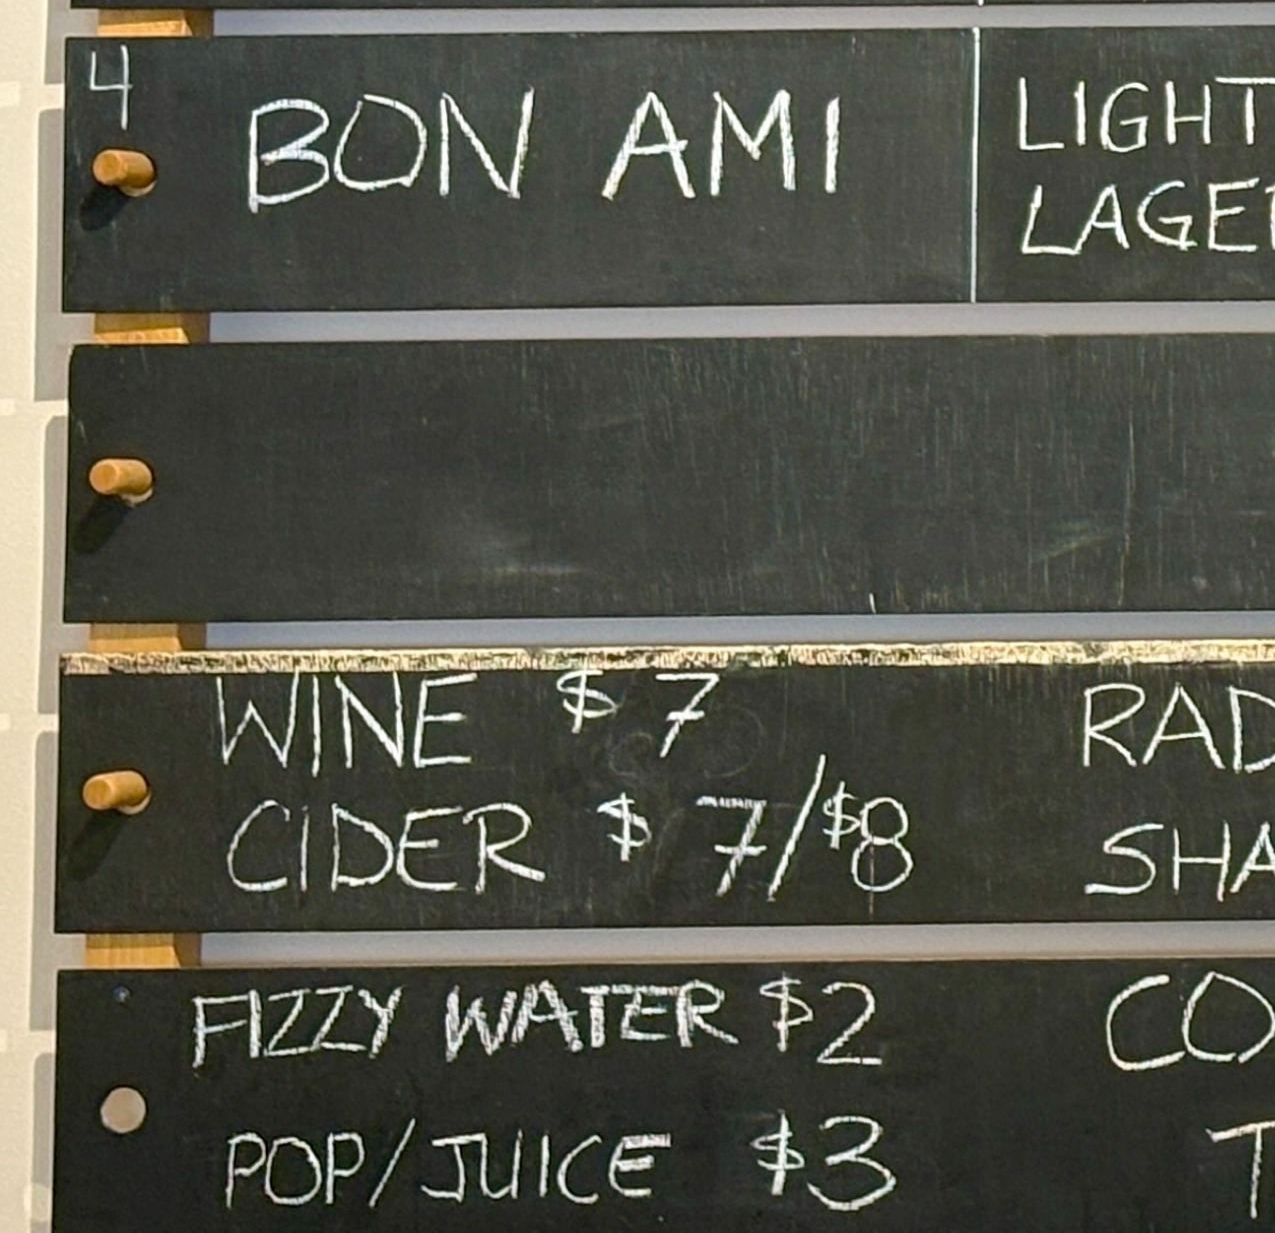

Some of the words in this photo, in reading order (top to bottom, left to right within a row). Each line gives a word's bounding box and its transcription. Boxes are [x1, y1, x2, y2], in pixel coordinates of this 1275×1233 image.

[88, 45, 133, 131] 4
[247, 86, 535, 213] BON
[601, 90, 840, 201] AMI
[214, 673, 477, 775] WINE
[226, 801, 546, 897] CIDER
[193, 985, 402, 1068] FIZZY
[445, 981, 739, 1062] WATER
[760, 975, 883, 1066] $2
[753, 1111, 897, 1212] $3
